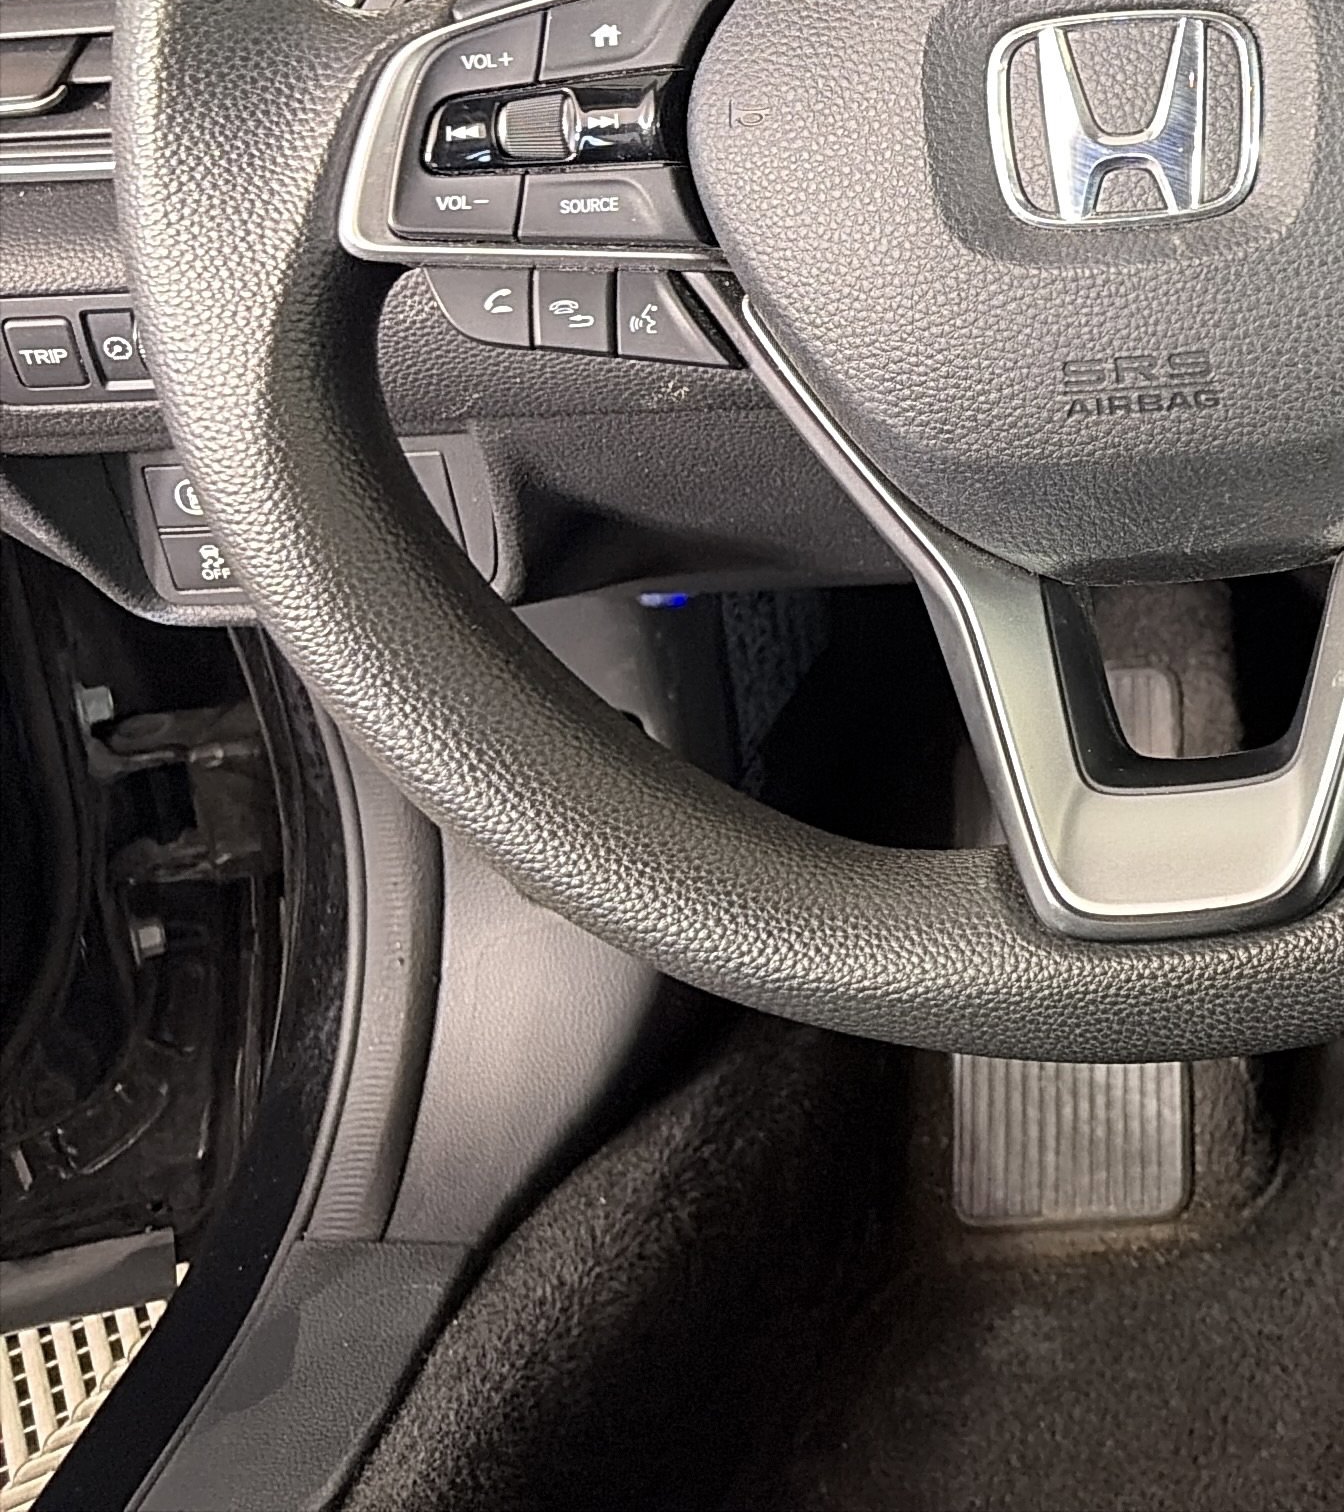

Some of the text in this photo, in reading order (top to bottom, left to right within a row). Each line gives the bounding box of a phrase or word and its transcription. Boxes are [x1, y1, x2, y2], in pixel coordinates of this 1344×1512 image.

[560, 196, 619, 214] SOURCE
[19, 347, 68, 366] TRIP
[1063, 350, 1212, 387] SRS
[1066, 390, 1221, 418] AIRBAG
[201, 567, 231, 581] OFF
